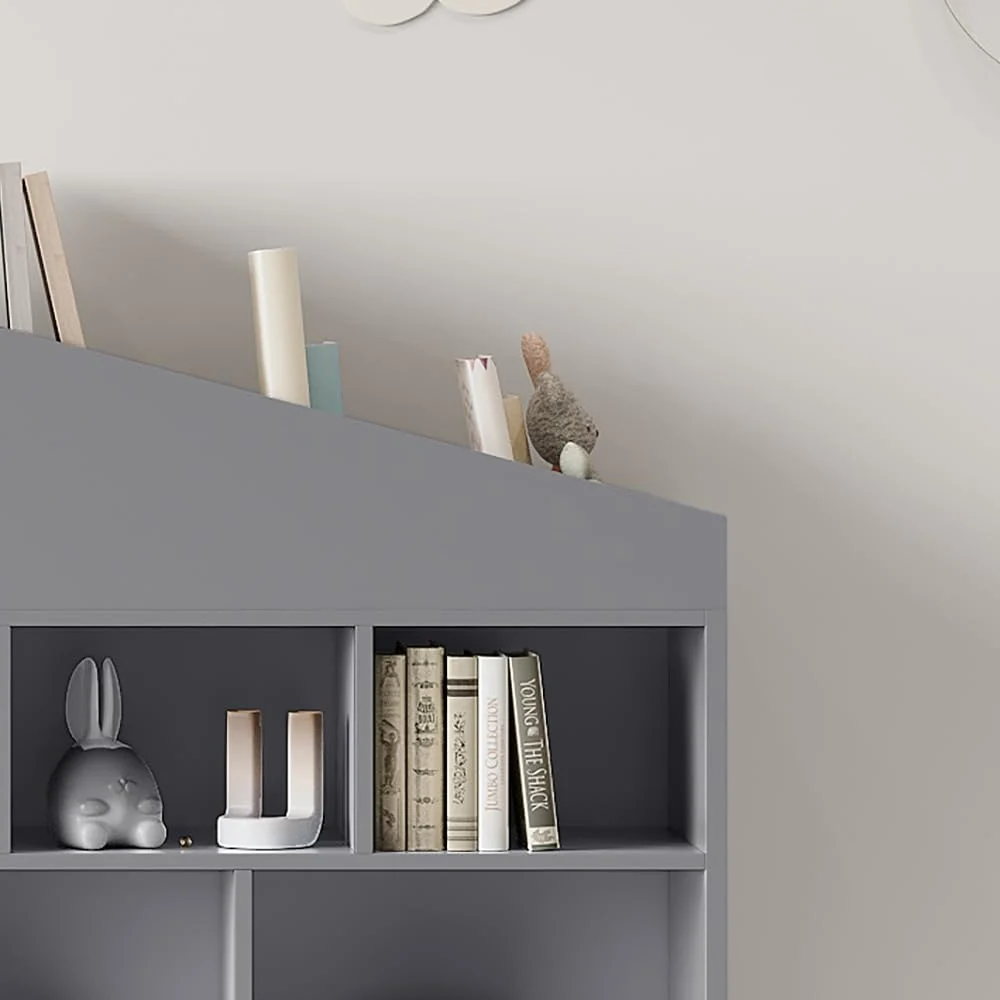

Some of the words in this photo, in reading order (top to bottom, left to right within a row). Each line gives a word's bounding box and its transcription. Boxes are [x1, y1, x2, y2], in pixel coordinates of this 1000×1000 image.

[519, 678, 539, 726] YOUNG
[486, 697, 499, 769] COLLECTION
[522, 738, 543, 767] THE
[485, 771, 502, 813] JUMBO
[526, 767, 549, 812] SHACK
